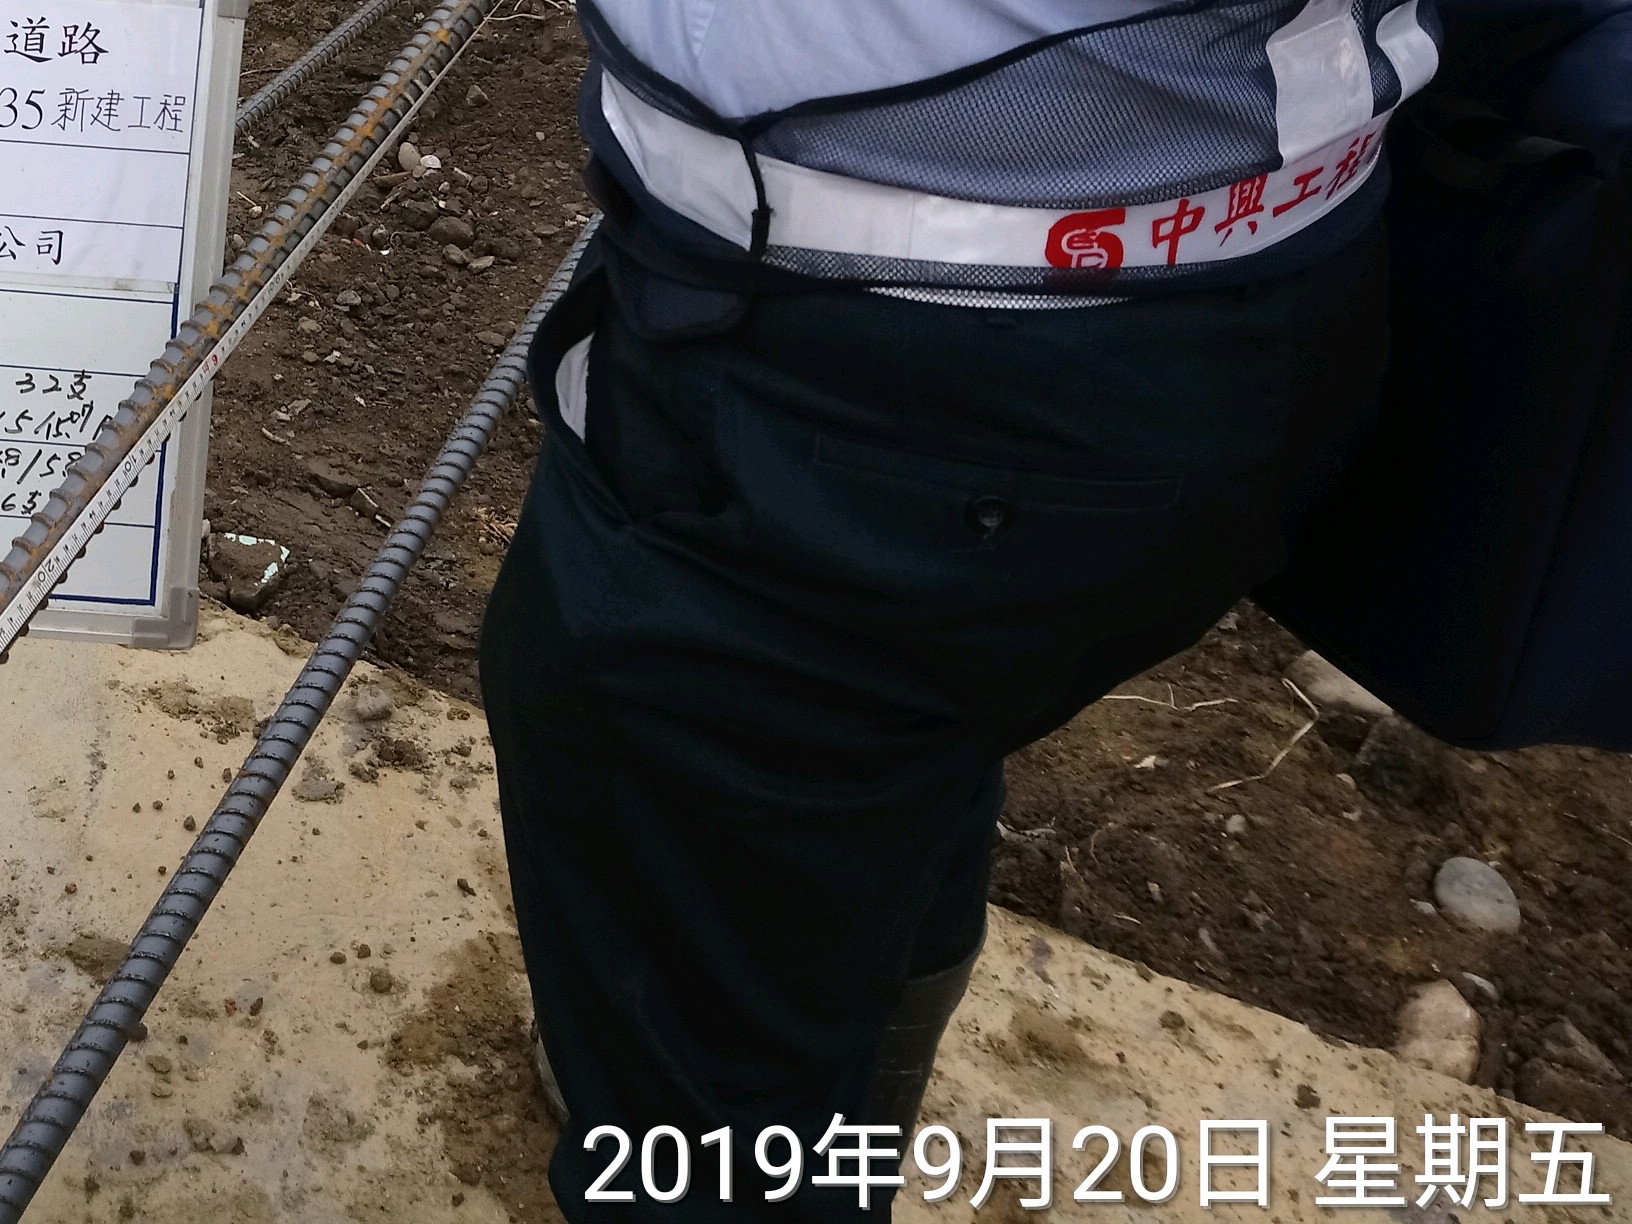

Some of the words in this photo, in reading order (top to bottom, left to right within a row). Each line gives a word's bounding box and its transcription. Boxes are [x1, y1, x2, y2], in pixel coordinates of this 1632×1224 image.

[50, 87, 186, 134] 新建工程
[38, 559, 56, 582] 20
